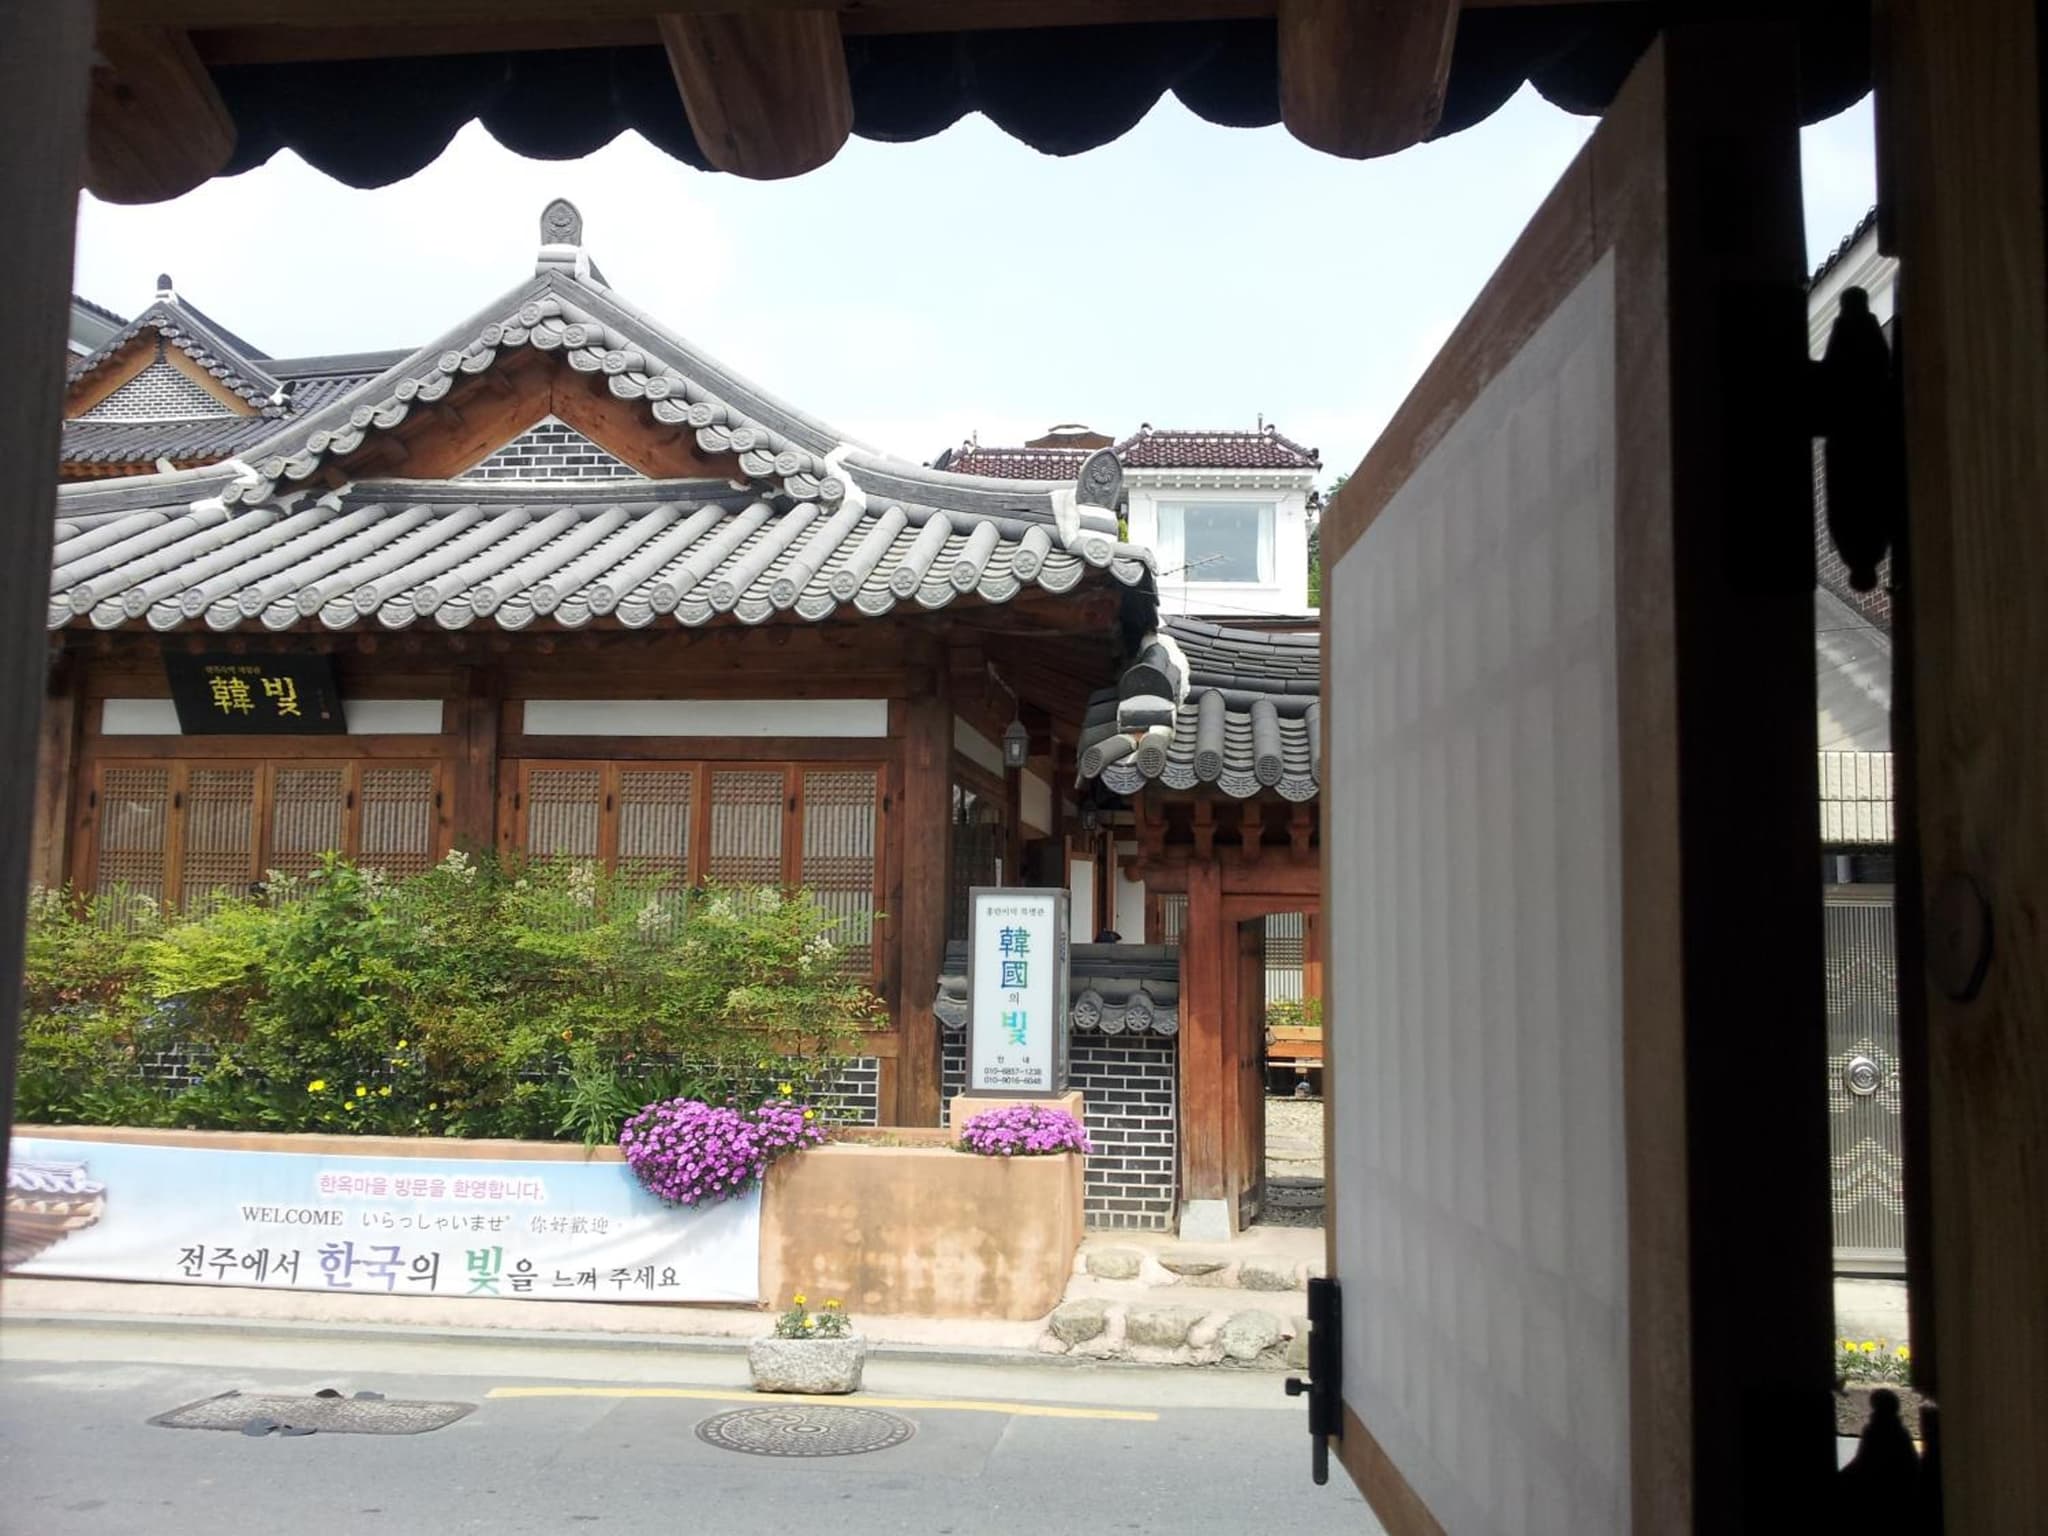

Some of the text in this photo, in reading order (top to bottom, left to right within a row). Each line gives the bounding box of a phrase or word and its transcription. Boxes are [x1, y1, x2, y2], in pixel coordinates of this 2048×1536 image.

[320, 1175, 545, 1200] 한옥마을 방문을 환영합니다.
[242, 1206, 343, 1227] WELCOME
[177, 1240, 681, 1295] 전주에서 한국의 빛을 느껴 주세요
